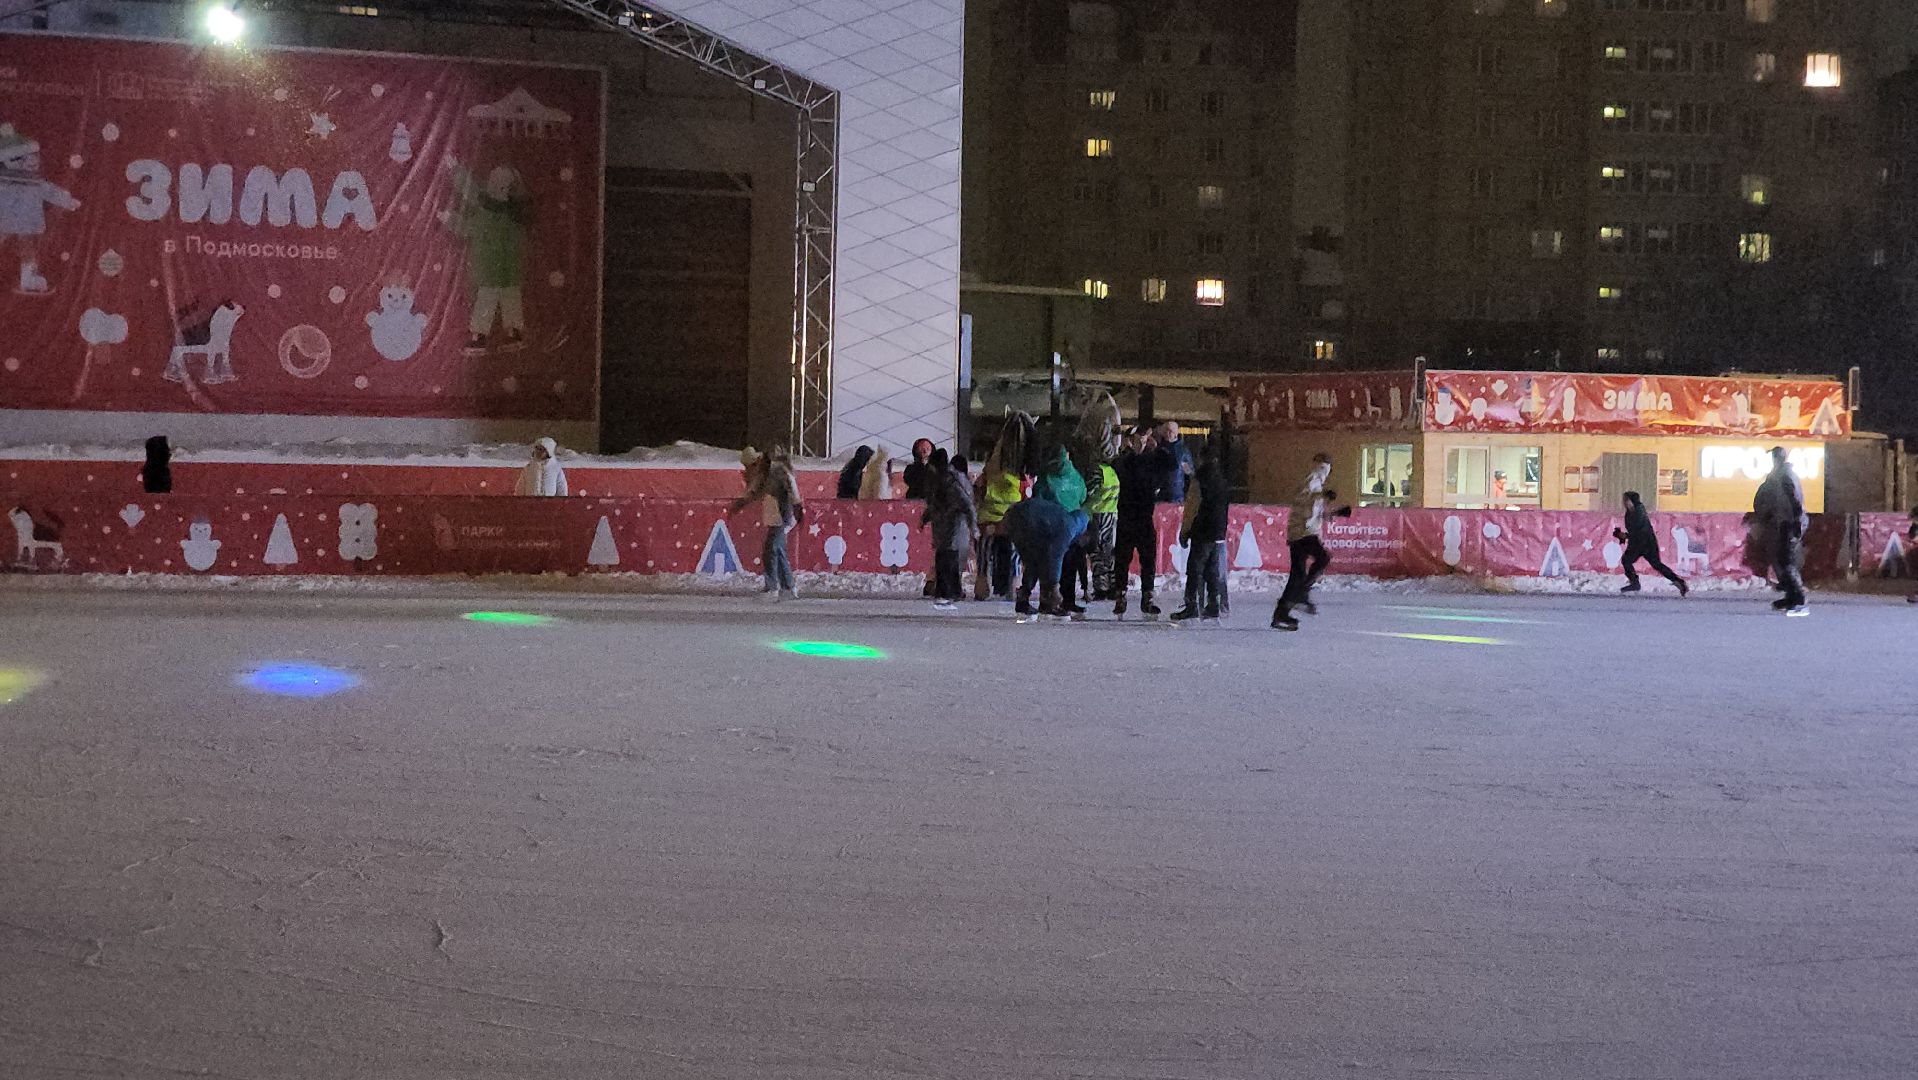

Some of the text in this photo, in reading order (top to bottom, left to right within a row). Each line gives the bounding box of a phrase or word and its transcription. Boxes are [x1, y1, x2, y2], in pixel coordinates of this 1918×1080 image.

[126, 159, 378, 231] ЗИМА
[165, 235, 338, 260] в Подмосковье
[1603, 389, 1673, 411] ЗИМА
[1701, 445, 1825, 479] ПРОАТ
[461, 526, 503, 537] ПАРКИ
[1327, 521, 1389, 535] Катайтесь
